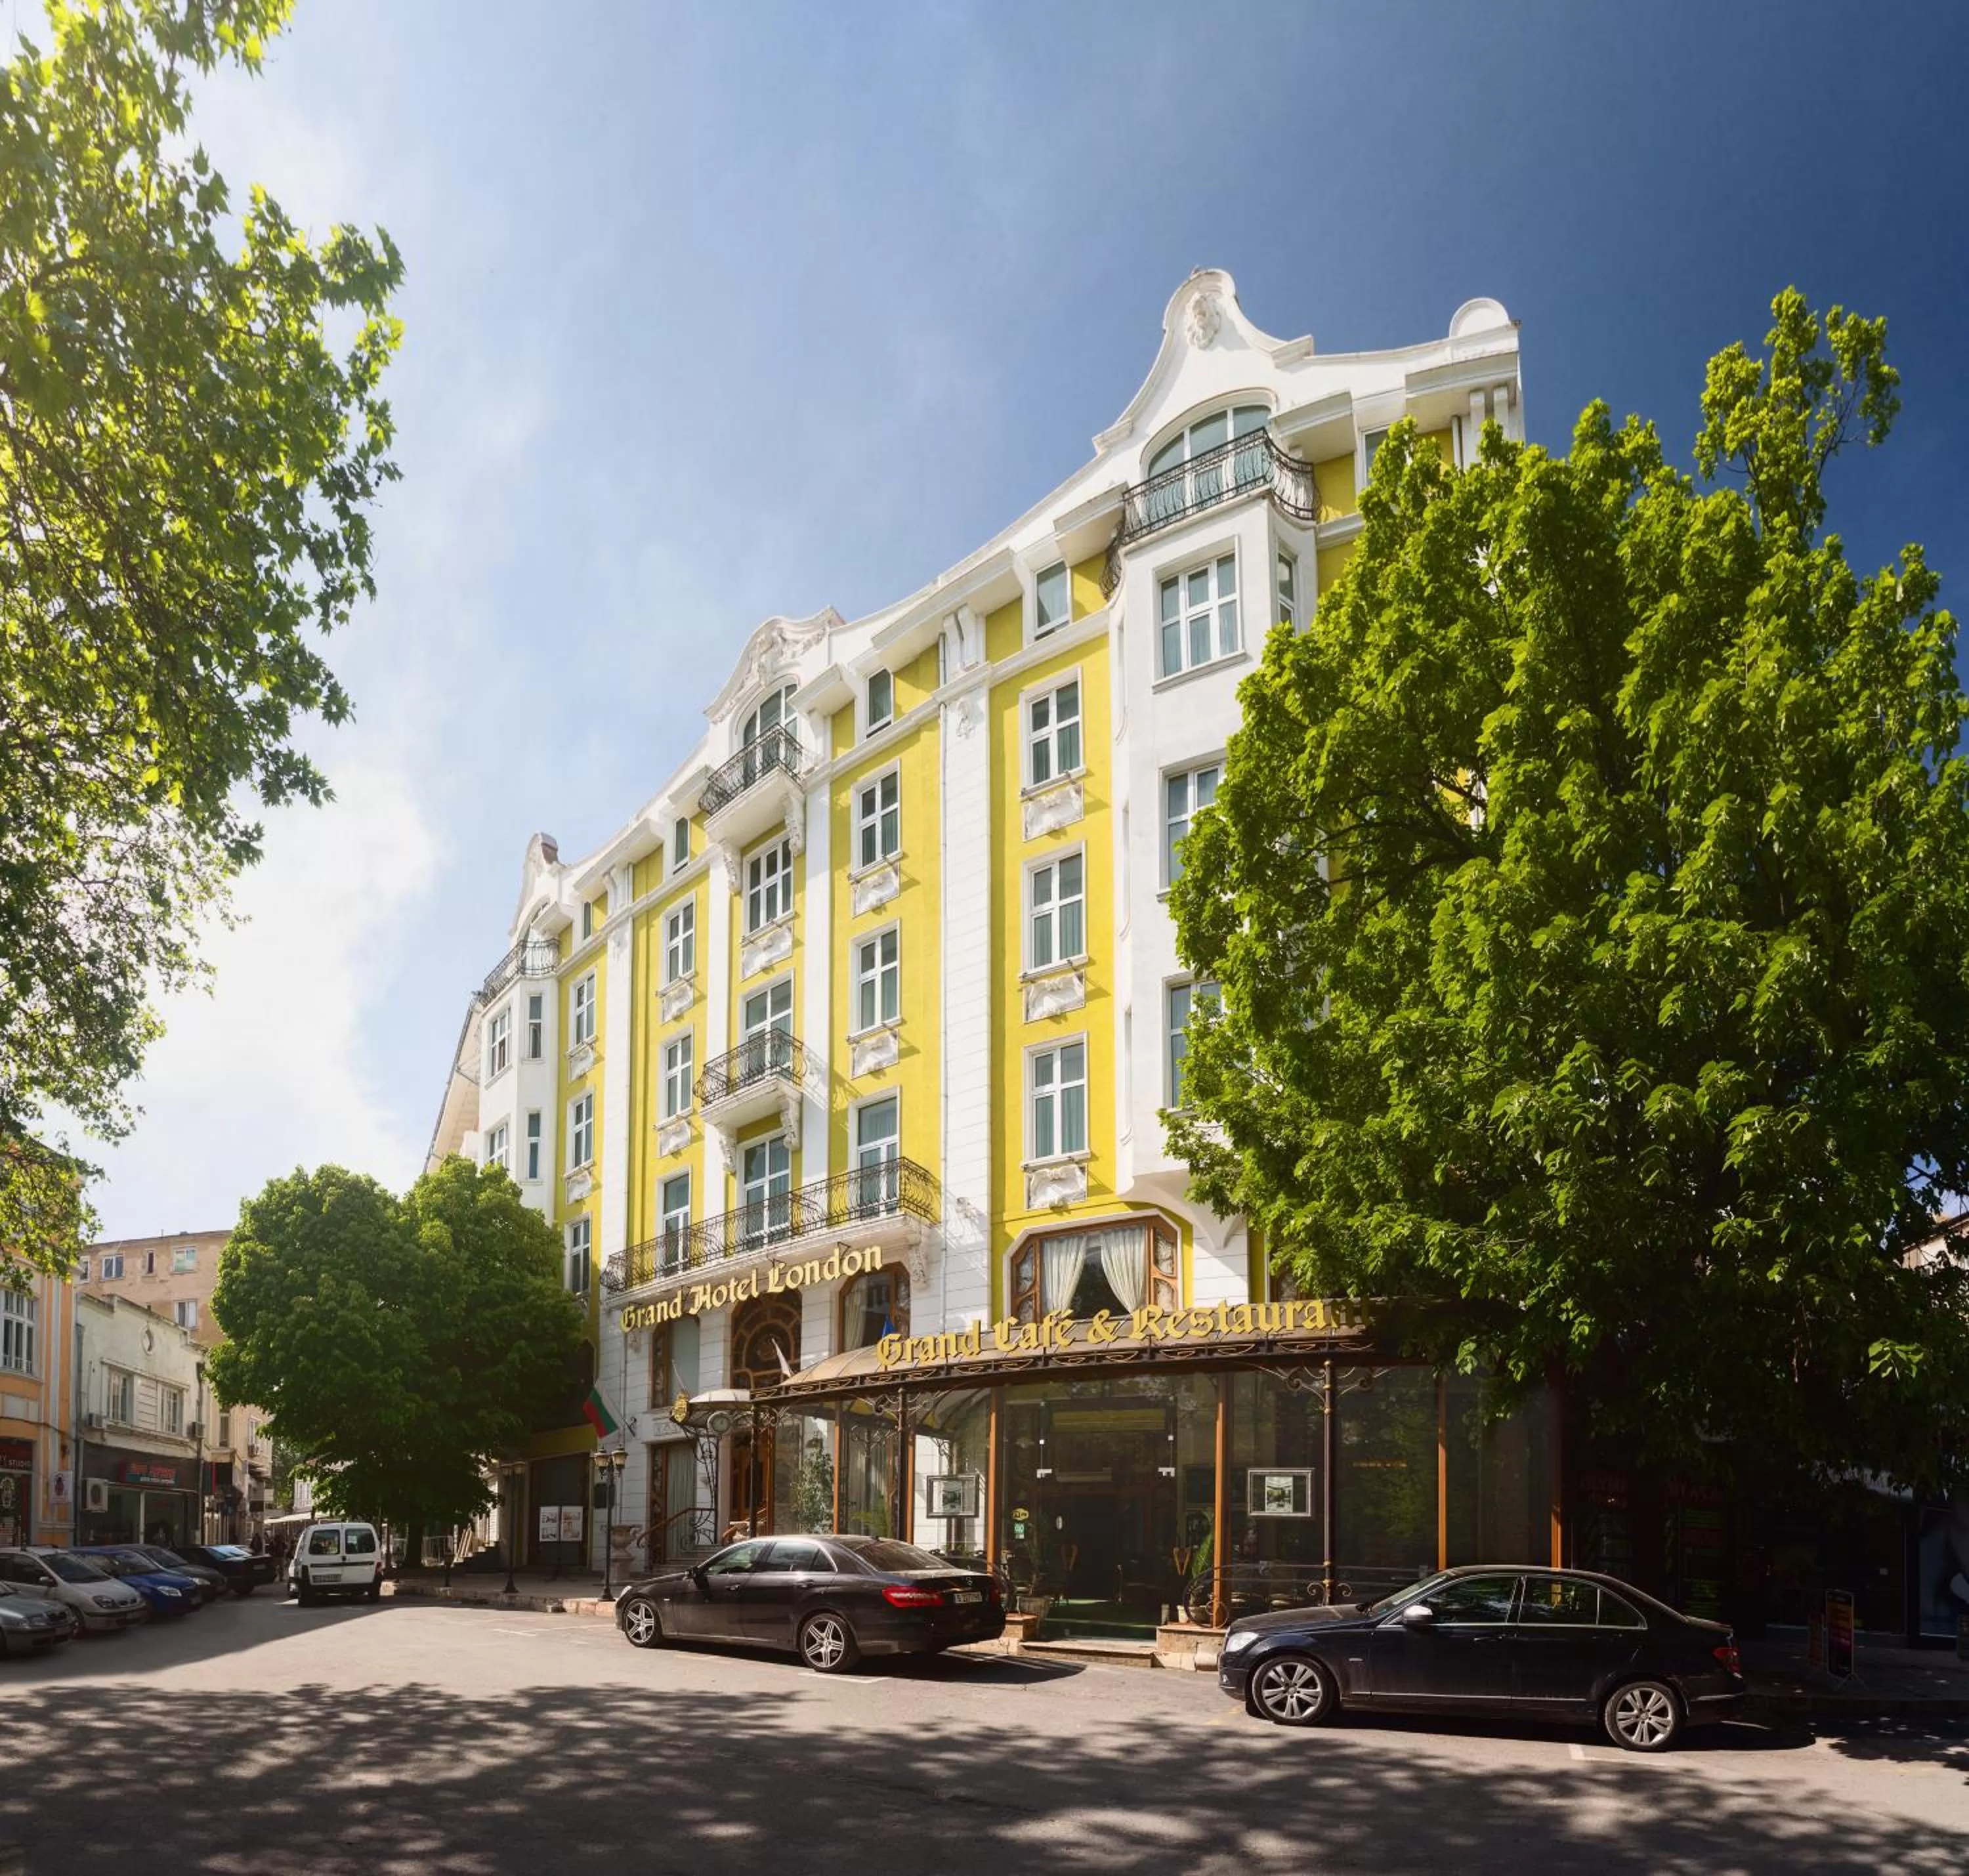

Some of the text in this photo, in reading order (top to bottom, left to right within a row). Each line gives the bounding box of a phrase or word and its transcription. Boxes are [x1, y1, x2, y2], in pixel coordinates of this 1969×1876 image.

[621, 1246, 883, 1333] Grand Hotel London
[877, 1319, 982, 1367] Grand
[994, 1308, 1075, 1352] Café
[1088, 1309, 1119, 1344] &
